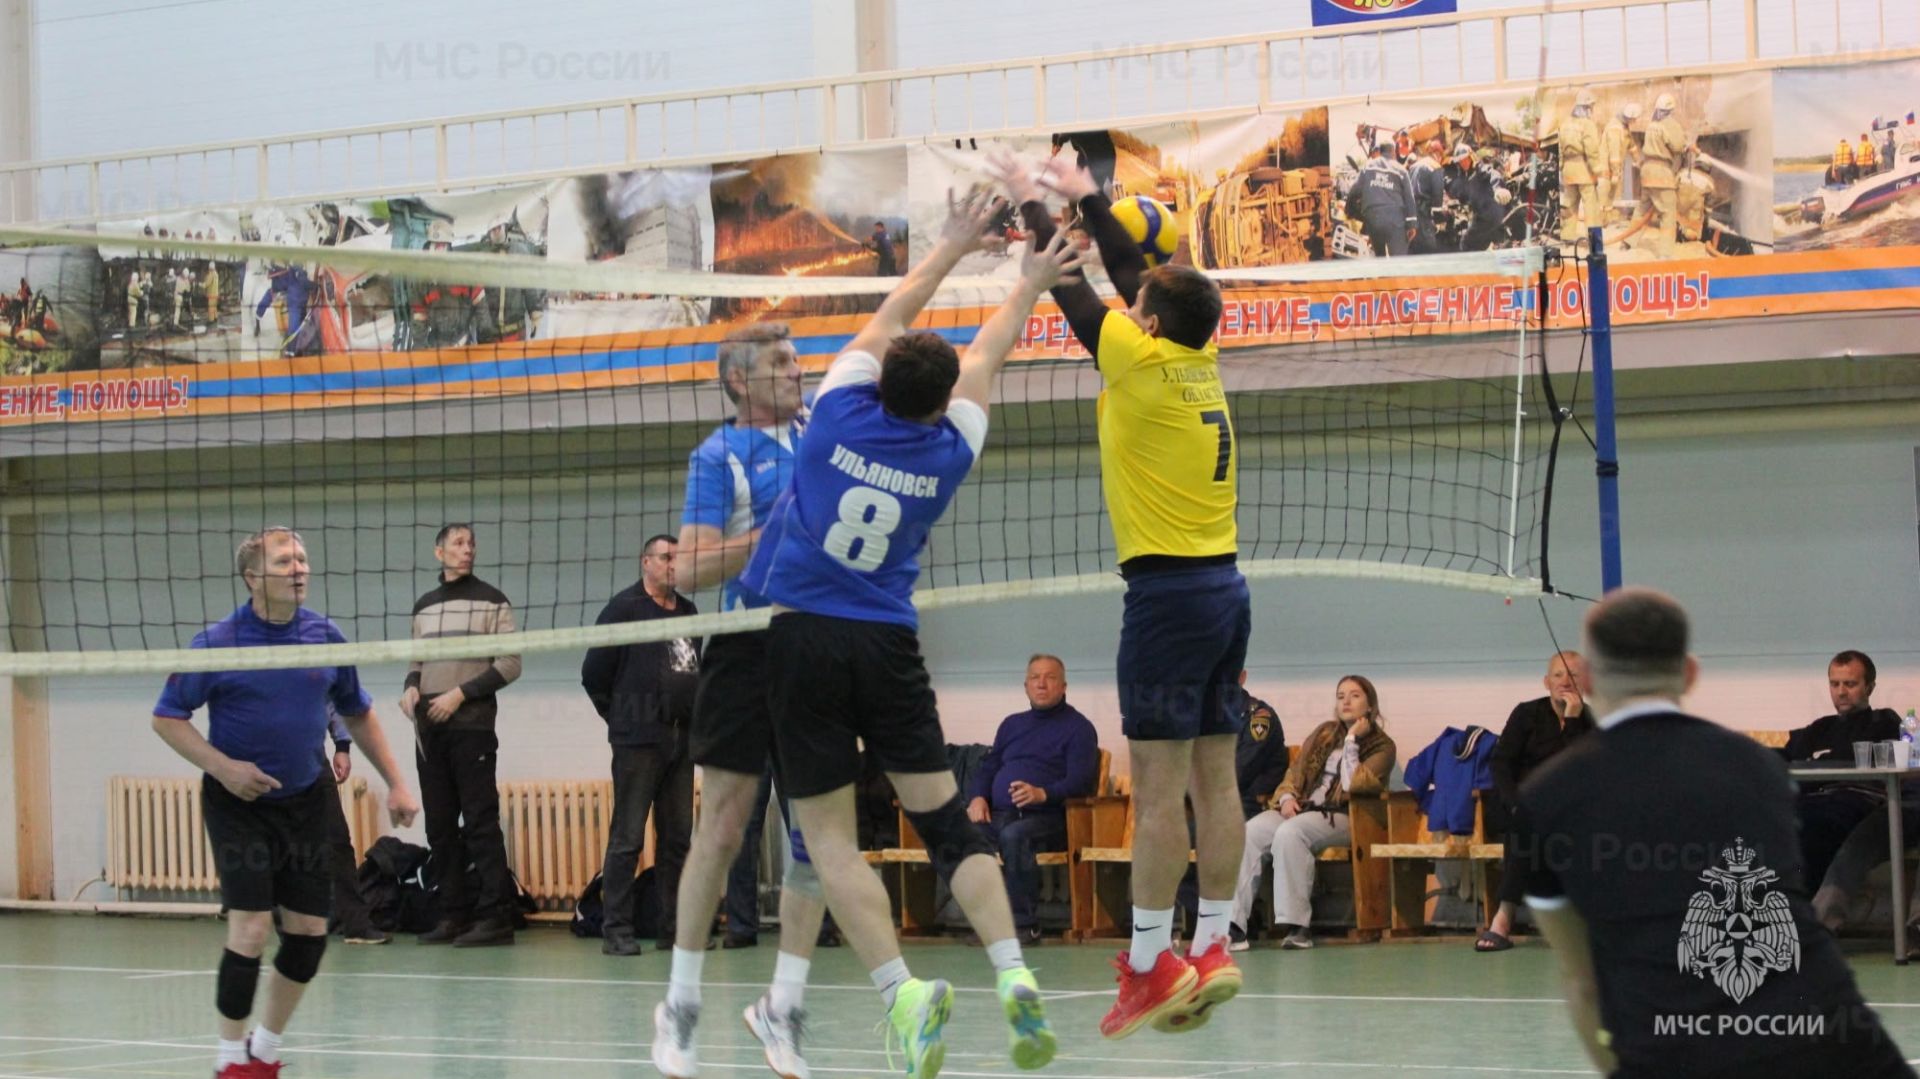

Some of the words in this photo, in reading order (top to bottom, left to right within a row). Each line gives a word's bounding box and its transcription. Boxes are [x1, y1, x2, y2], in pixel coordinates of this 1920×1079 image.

[1211, 296, 1321, 344] ЕНИЕ,
[1330, 283, 1523, 331] СПАСЕНИЕ,
[71, 375, 189, 415] ПОМОЩЬ!
[829, 443, 939, 498] УЛЬЯНОВСК
[1200, 409, 1231, 482] 7
[823, 486, 902, 573] 8
